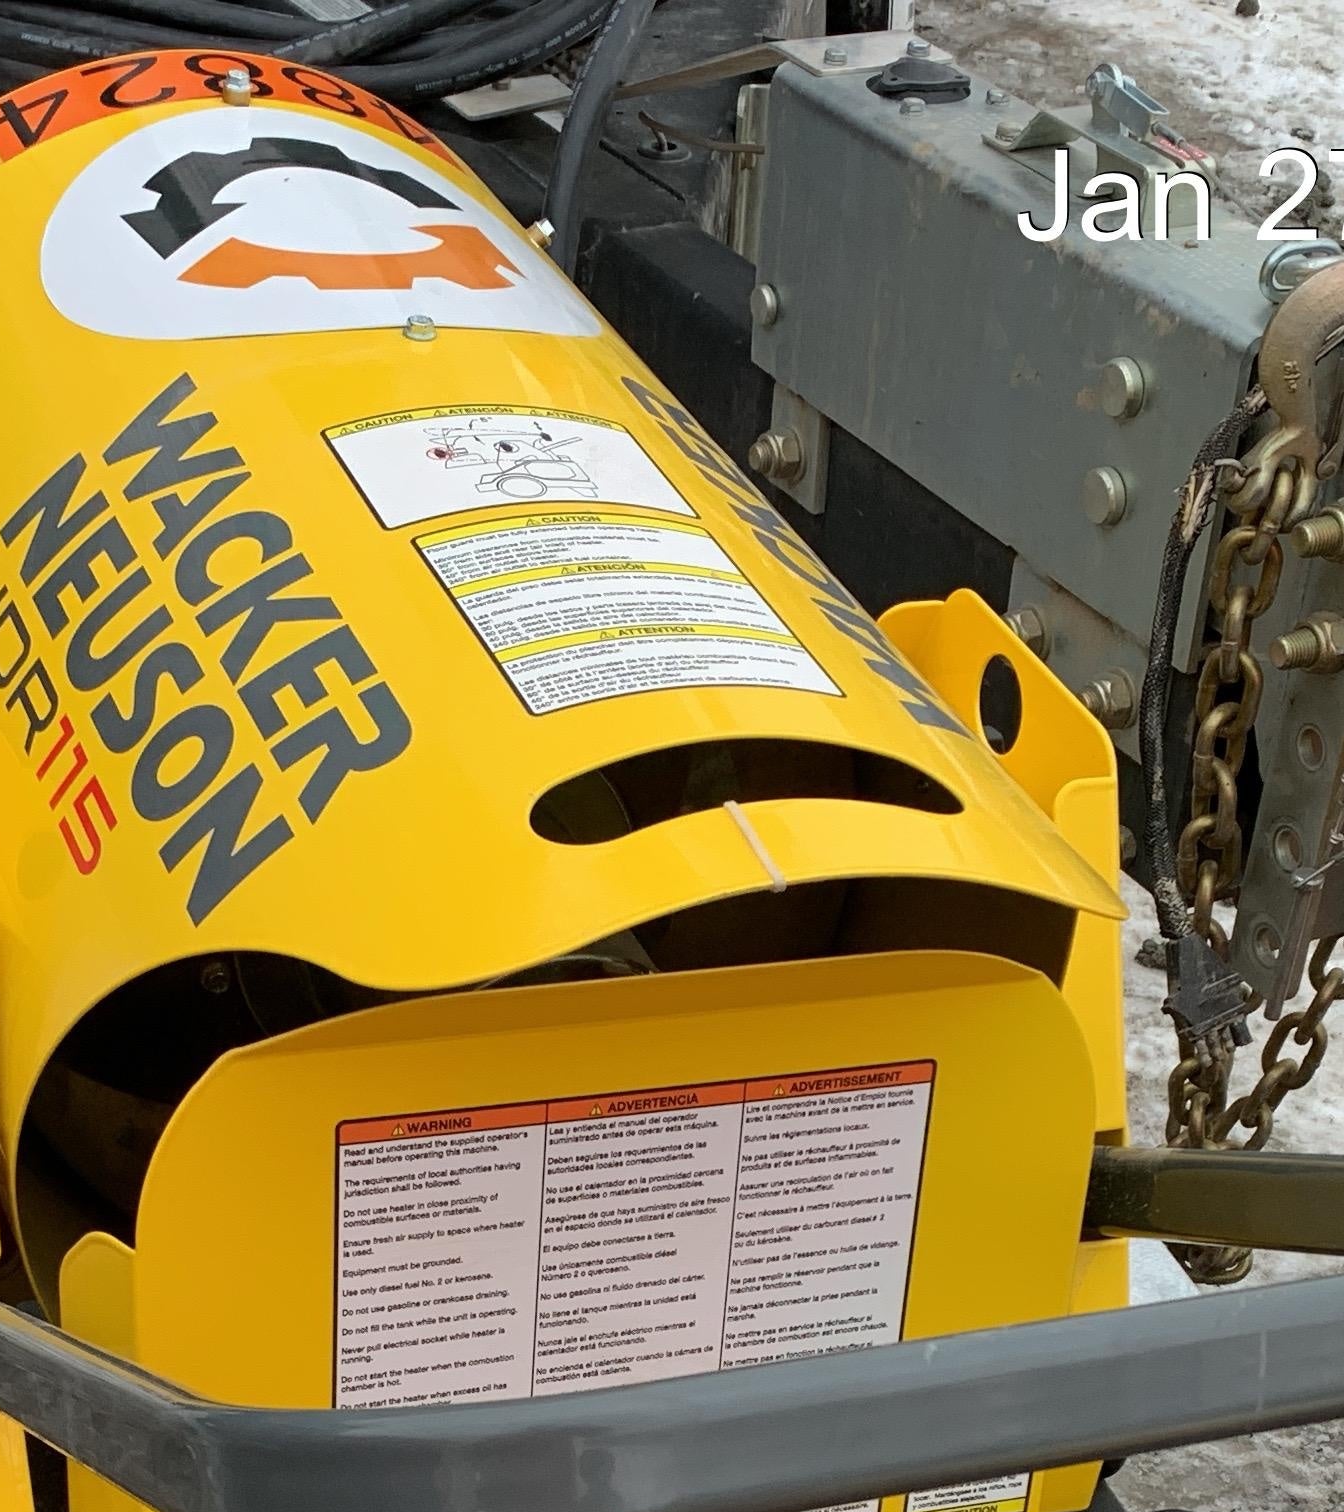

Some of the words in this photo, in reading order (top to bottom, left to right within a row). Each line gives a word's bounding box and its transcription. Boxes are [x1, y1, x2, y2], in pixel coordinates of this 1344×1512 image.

[354, 413, 414, 430] CAUTION
[541, 514, 602, 525] CAUTION
[577, 562, 646, 573] ATENCIÓN
[103, 372, 413, 825] WACKER
[617, 626, 696, 638] ATTENTION
[0, 452, 295, 928] NEUSON
[789, 1071, 902, 1094] ADVERTISSEMENT
[607, 1093, 699, 1113] ADVERTENCIA
[745, 1103, 761, 1114] Lire
[826, 1093, 853, 1105] Notice
[887, 1086, 914, 1099] fournie
[407, 1117, 472, 1134] WARNING
[768, 1130, 781, 1141] les
[343, 1145, 366, 1158] Read
[367, 1143, 384, 1155] and
[385, 1138, 433, 1153] understand
[434, 1136, 448, 1148] the
[486, 1128, 528, 1145] operator's
[343, 1154, 375, 1168] manual
[375, 1151, 403, 1164] before
[404, 1147, 444, 1163] operating
[445, 1145, 461, 1157] this
[462, 1141, 500, 1155] machine.
[344, 1176, 360, 1188] The
[361, 1171, 416, 1189] requirements
[427, 1167, 448, 1179] local
[449, 1163, 492, 1177] authorities
[493, 1159, 521, 1175] having
[343, 1183, 390, 1200] jurisdiction
[390, 1180, 411, 1193] shall
[424, 1175, 462, 1189] followed.
[342, 1207, 356, 1219] Do
[356, 1205, 371, 1217] not
[372, 1206, 388, 1215] use
[388, 1200, 415, 1213] heater
[426, 1197, 449, 1209] close
[449, 1192, 488, 1209] proximity
[342, 1212, 394, 1228] combustible
[395, 1208, 431, 1222] surfaces
[442, 1202, 482, 1217] materials.
[551, 1240, 580, 1254] equipo
[580, 1237, 602, 1249] debe
[341, 1263, 387, 1280] Equipment
[387, 1260, 409, 1273] must
[421, 1254, 464, 1271] grounded.
[341, 1285, 359, 1298] Use
[359, 1283, 377, 1297] only
[378, 1280, 403, 1293] diesel
[404, 1278, 420, 1290] fuel
[454, 1268, 494, 1284] kerosene.
[539, 1290, 552, 1301] No
[552, 1290, 568, 1299] use
[568, 1284, 602, 1300] gasolina
[634, 1276, 667, 1289] drenado
[667, 1274, 681, 1285] del
[341, 1306, 354, 1317] Do
[354, 1304, 369, 1316] not
[370, 1304, 386, 1314] use
[386, 1297, 421, 1314] gasoline
[432, 1291, 474, 1306] crankcase
[474, 1287, 510, 1303] draining.
